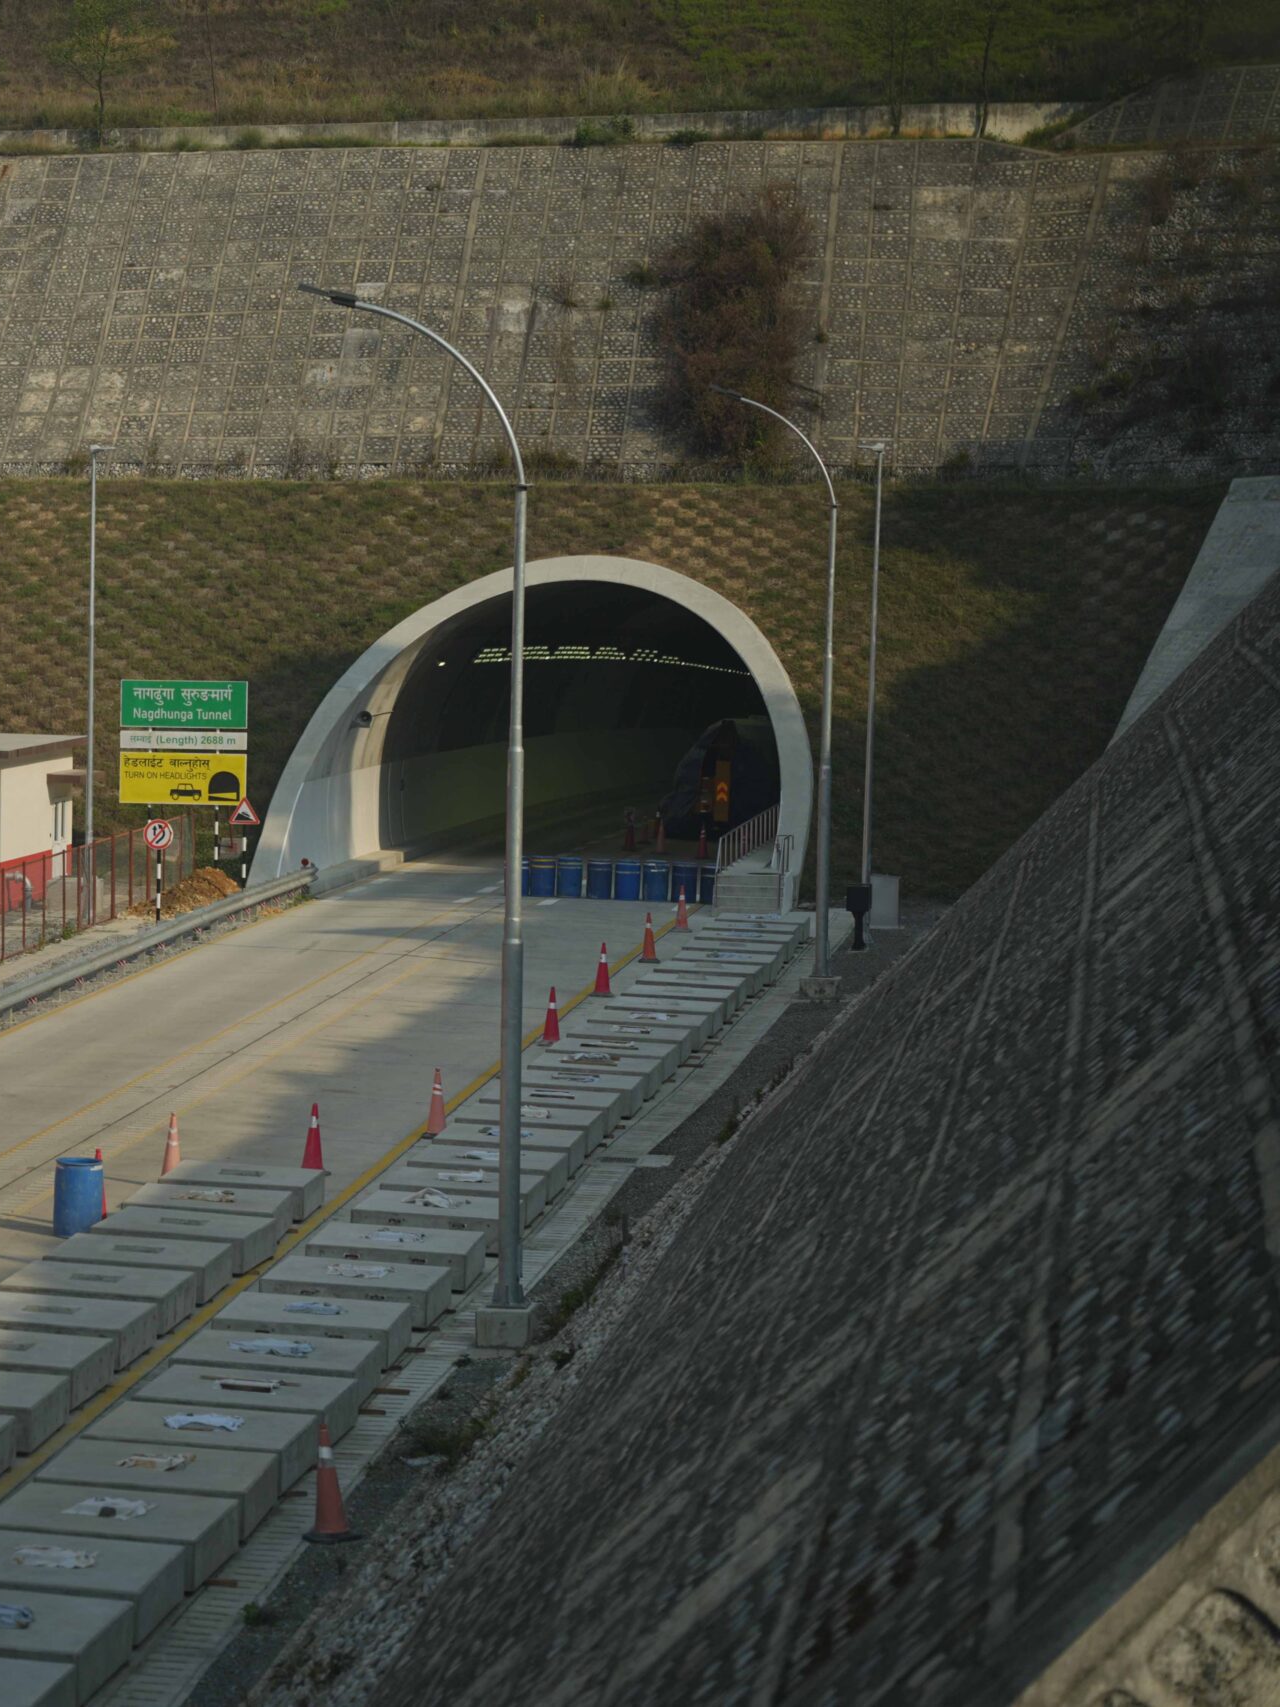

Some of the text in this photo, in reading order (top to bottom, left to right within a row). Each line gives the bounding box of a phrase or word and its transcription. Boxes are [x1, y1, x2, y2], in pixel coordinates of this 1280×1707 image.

[133, 708, 232, 722] Nagdhunga Tunnel
[156, 735, 198, 746] (Length)
[200, 736, 224, 745] 2688
[124, 771, 207, 780] TURN ON HEADLIGHTS
